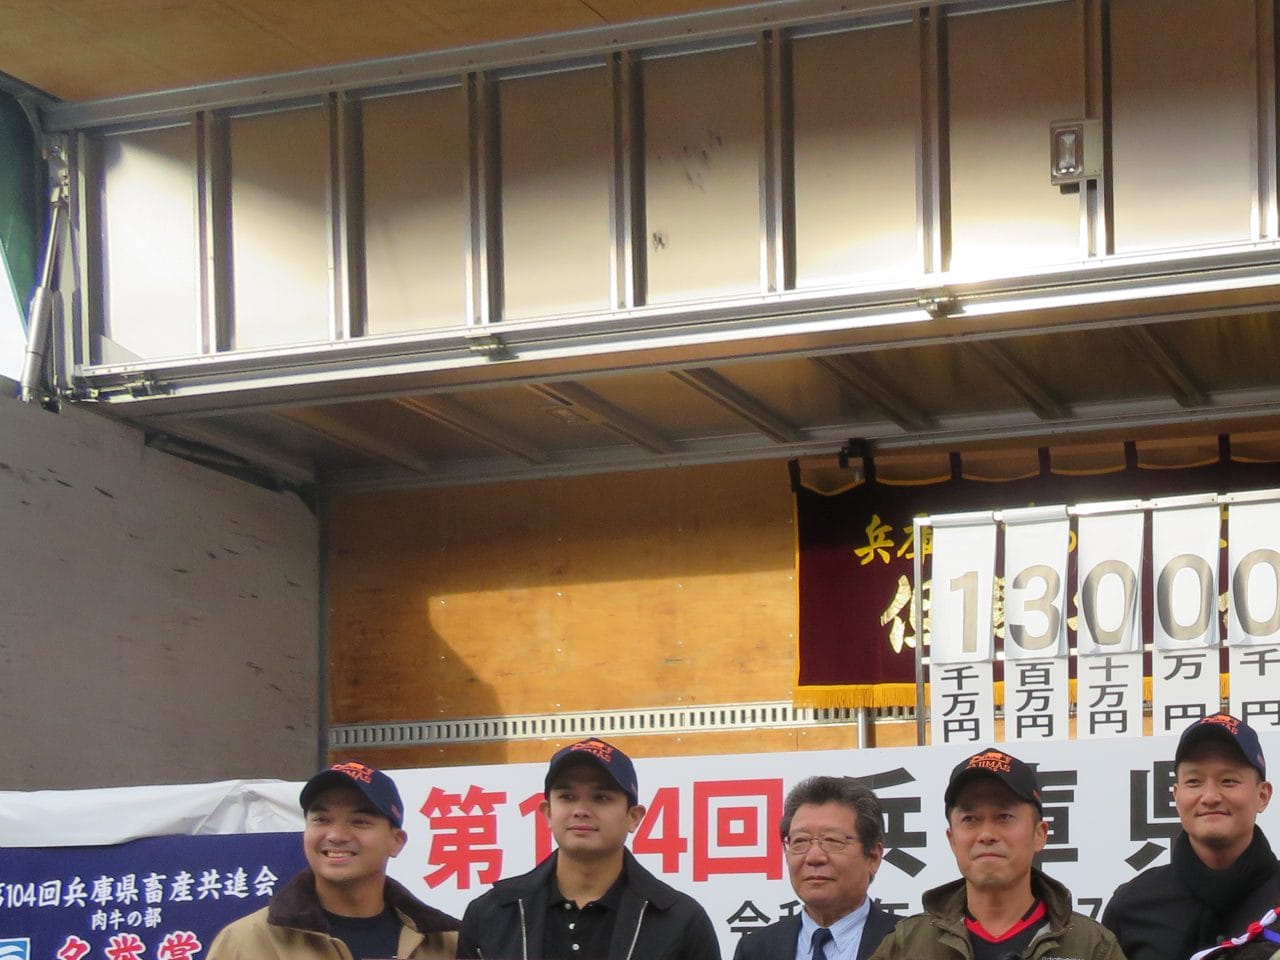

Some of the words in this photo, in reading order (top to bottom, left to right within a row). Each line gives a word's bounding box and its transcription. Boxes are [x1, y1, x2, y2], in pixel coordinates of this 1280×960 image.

[940, 665, 980, 744] 千万円
[1016, 661, 1055, 739] 百万円
[1088, 657, 1129, 735] 十万円
[419, 776, 784, 890] 第14回
[91, 906, 163, 931] 肉牛の部
